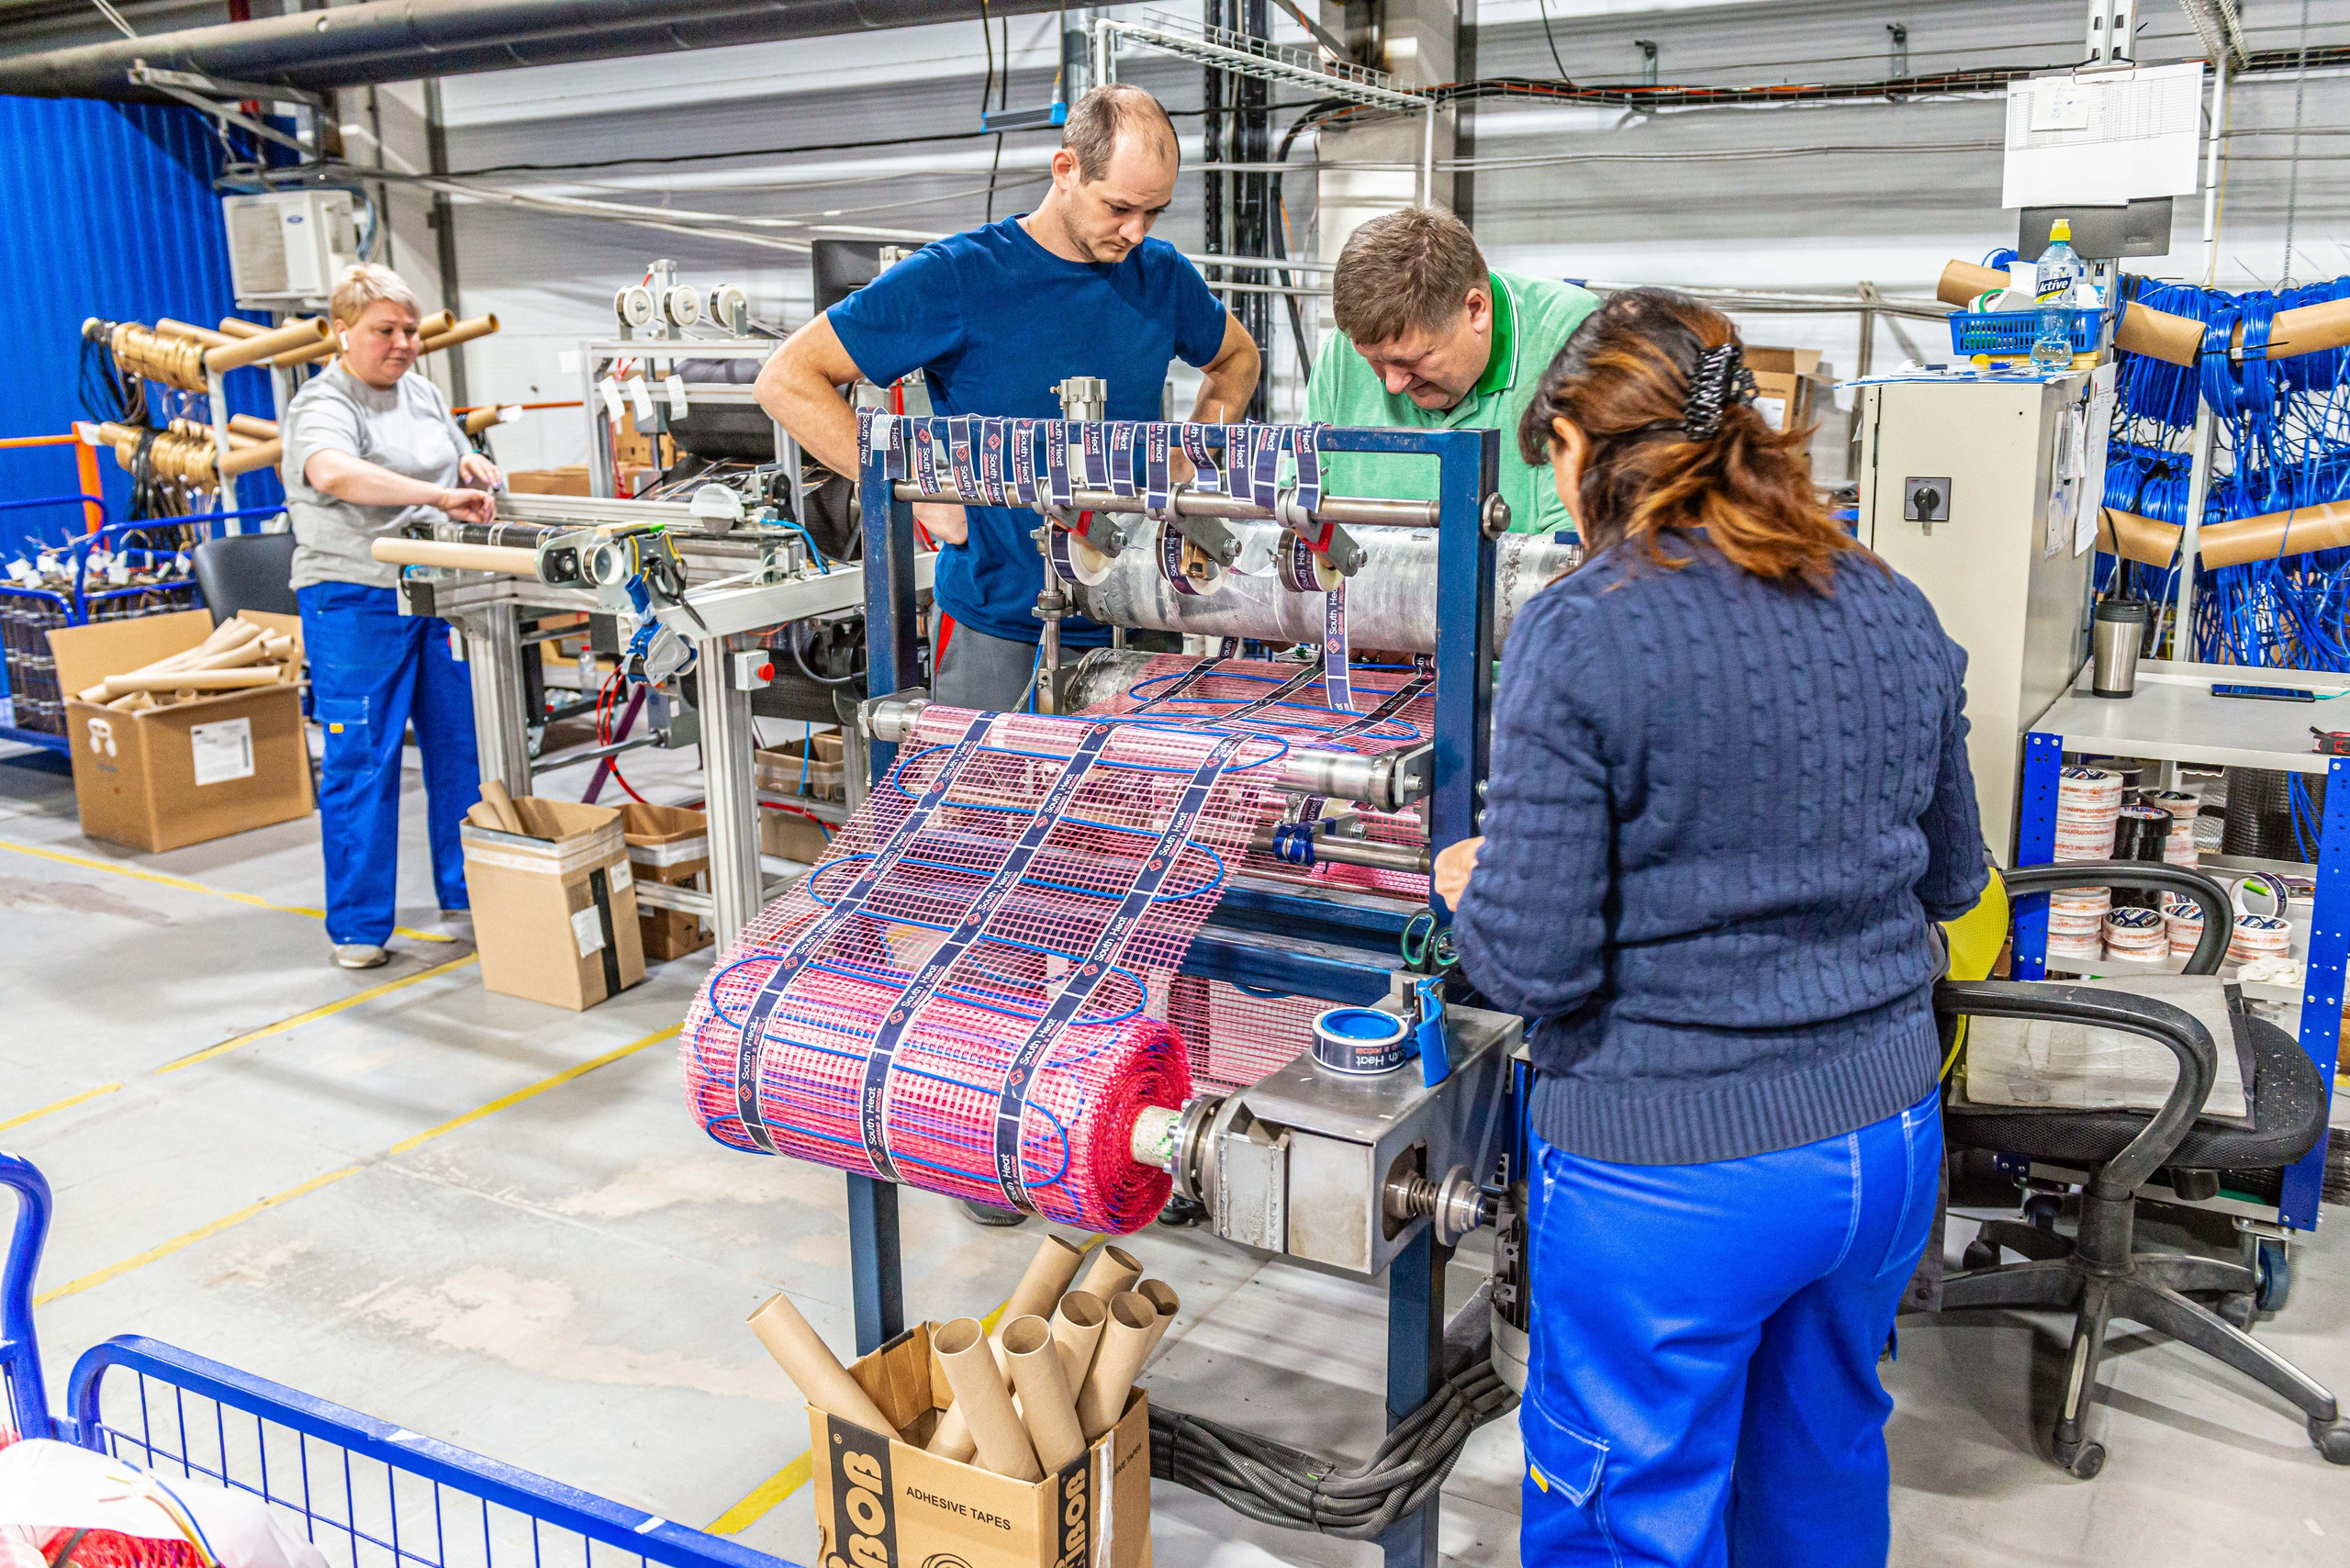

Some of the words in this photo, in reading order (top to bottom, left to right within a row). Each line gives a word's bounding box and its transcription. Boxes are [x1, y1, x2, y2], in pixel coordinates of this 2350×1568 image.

[891, 427, 901, 450] Heat
[1091, 431, 1100, 454] Heat
[1120, 428, 1131, 451] Heat
[1156, 439, 1165, 463] Heat
[1267, 427, 1279, 452] Heat
[1303, 430, 1312, 454] Heat
[923, 447, 932, 473] South
[990, 454, 998, 479] South
[1056, 443, 1064, 467] Heat
[1237, 444, 1246, 468] Heat
[926, 476, 935, 494] Hea
[960, 465, 972, 491] South
[1022, 462, 1031, 485] Heat
[991, 483, 1002, 503] Heat
[1168, 553, 1179, 577] South
[1297, 543, 1305, 566] Heat
[1329, 610, 1337, 635] South
[1224, 640, 1232, 656] outh
[941, 759, 958, 778] South
[956, 740, 972, 757] Heat
[1045, 792, 1063, 813] South
[1058, 773, 1075, 791] Heat
[1158, 834, 1177, 856] South
[1171, 812, 1189, 832] Heat
[875, 851, 894, 869] South
[891, 831, 909, 848] Heat
[977, 890, 999, 911] South
[993, 870, 1013, 889] Heat
[796, 935, 816, 955] South
[1094, 938, 1114, 962] South
[1109, 915, 1128, 935] Heat
[901, 986, 923, 1007] South
[919, 964, 940, 983] Heat
[744, 1018, 759, 1047] Heat
[1019, 1040, 1042, 1065] South
[1035, 1017, 1058, 1038] Heat
[742, 1051, 751, 1081] South
[1355, 1056, 1384, 1067] Heat
[866, 1087, 876, 1114] Heat
[867, 1118, 877, 1145] South
[1000, 1153, 1012, 1178] Heat
[1007, 1182, 1021, 1202] South
[906, 1485, 967, 1516] ADHESIVE
[970, 1506, 1011, 1530] TAPES
